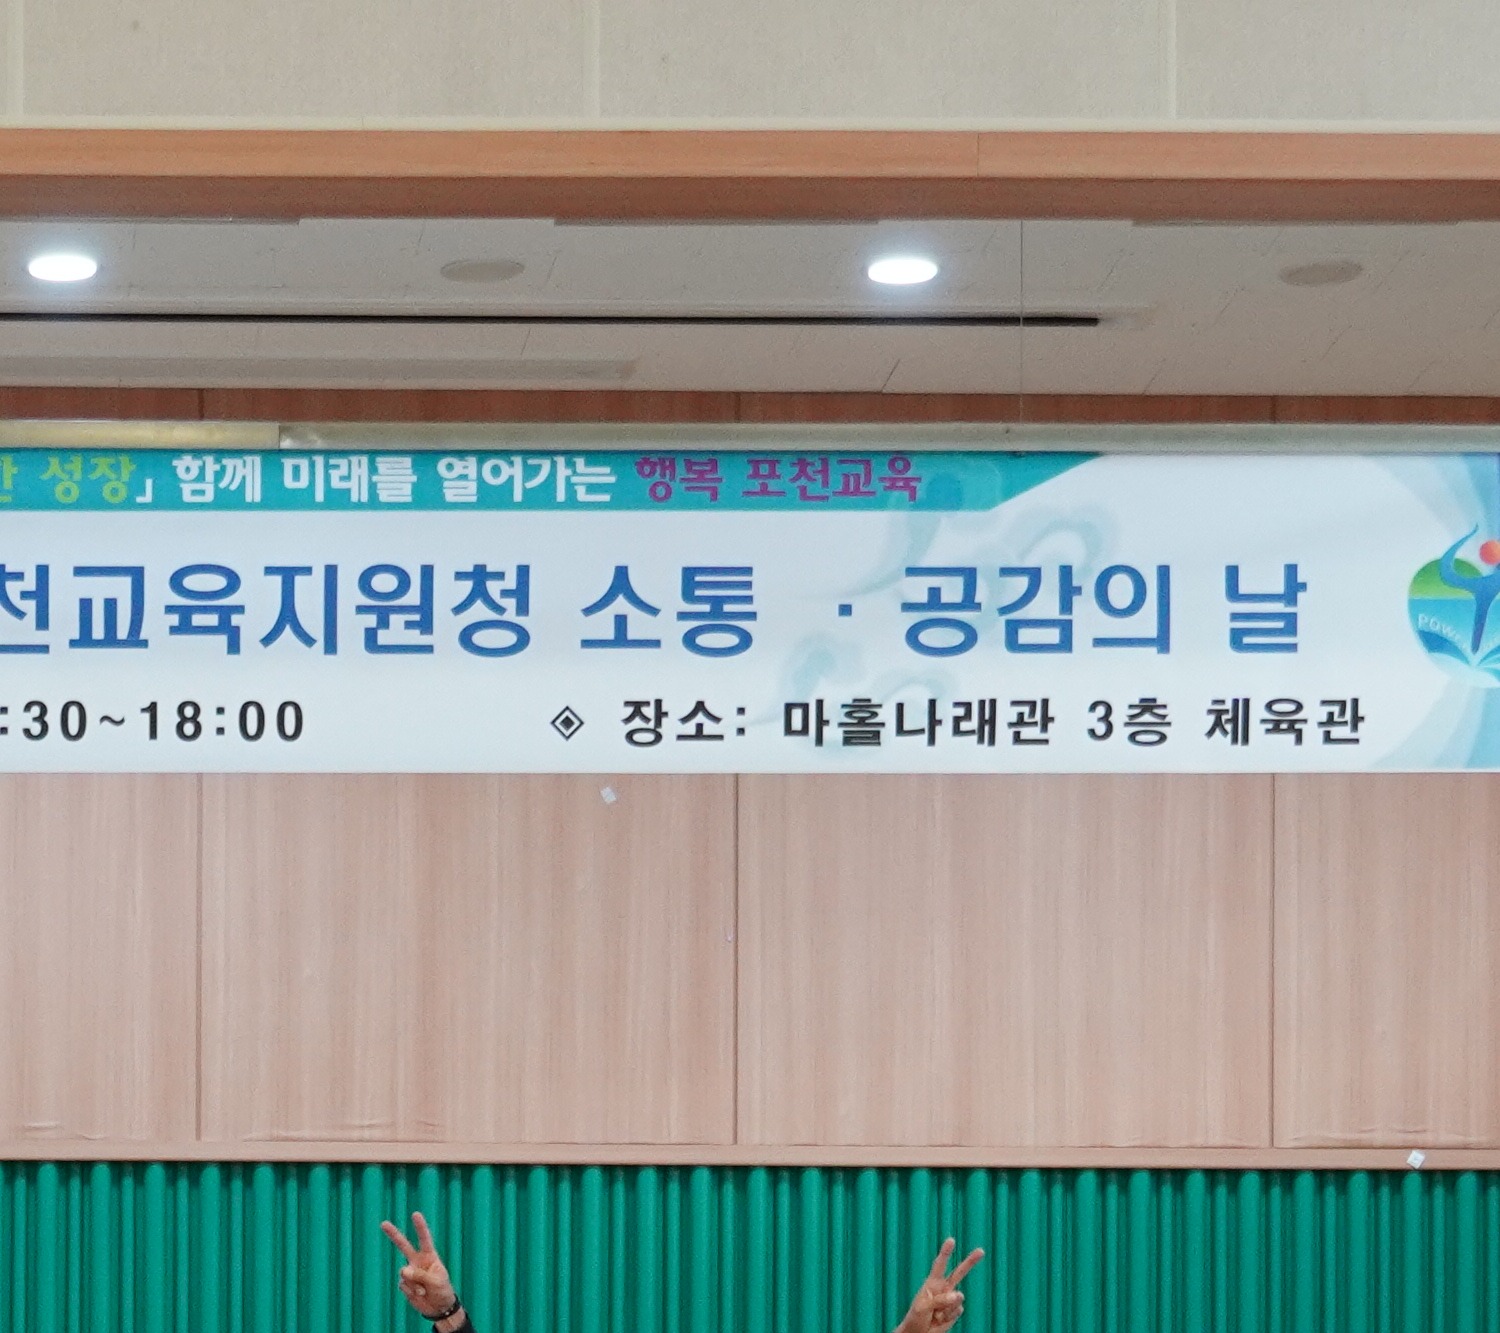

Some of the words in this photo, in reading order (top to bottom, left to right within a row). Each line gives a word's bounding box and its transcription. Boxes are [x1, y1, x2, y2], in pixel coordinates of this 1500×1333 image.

[174, 455, 262, 506] 함께
[283, 455, 418, 505] 미래를
[437, 455, 617, 506] 열어가는
[634, 455, 720, 504] 행복
[741, 455, 924, 504] 포천교육
[579, 562, 758, 656] 소통
[901, 562, 1174, 656] 공감의
[1223, 562, 1307, 656] 날
[620, 698, 750, 747] 장소:
[783, 698, 1057, 749] 마홀나래관
[1089, 700, 1173, 749] 3층
[1205, 698, 1365, 749] 체육관
